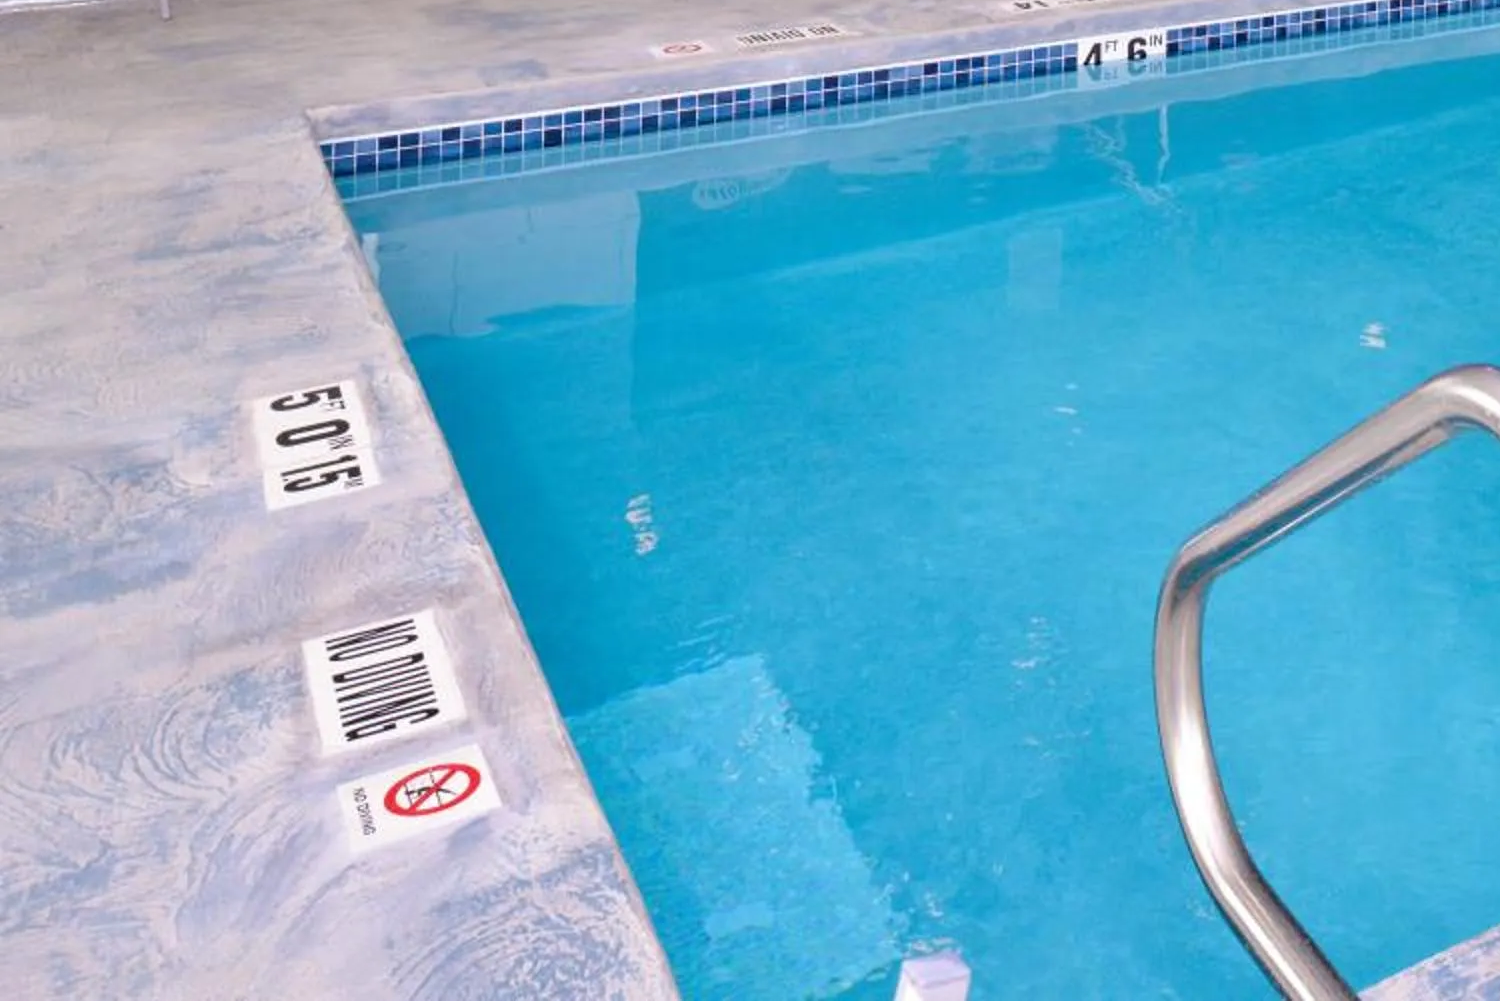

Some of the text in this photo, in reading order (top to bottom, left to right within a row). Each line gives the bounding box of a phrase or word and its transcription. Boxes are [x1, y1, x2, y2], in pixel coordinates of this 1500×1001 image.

[1083, 34, 1163, 66] 4 FT 6 IN
[270, 385, 343, 412] 5
[276, 418, 350, 447] 0
[324, 618, 441, 742] NO DIVING
